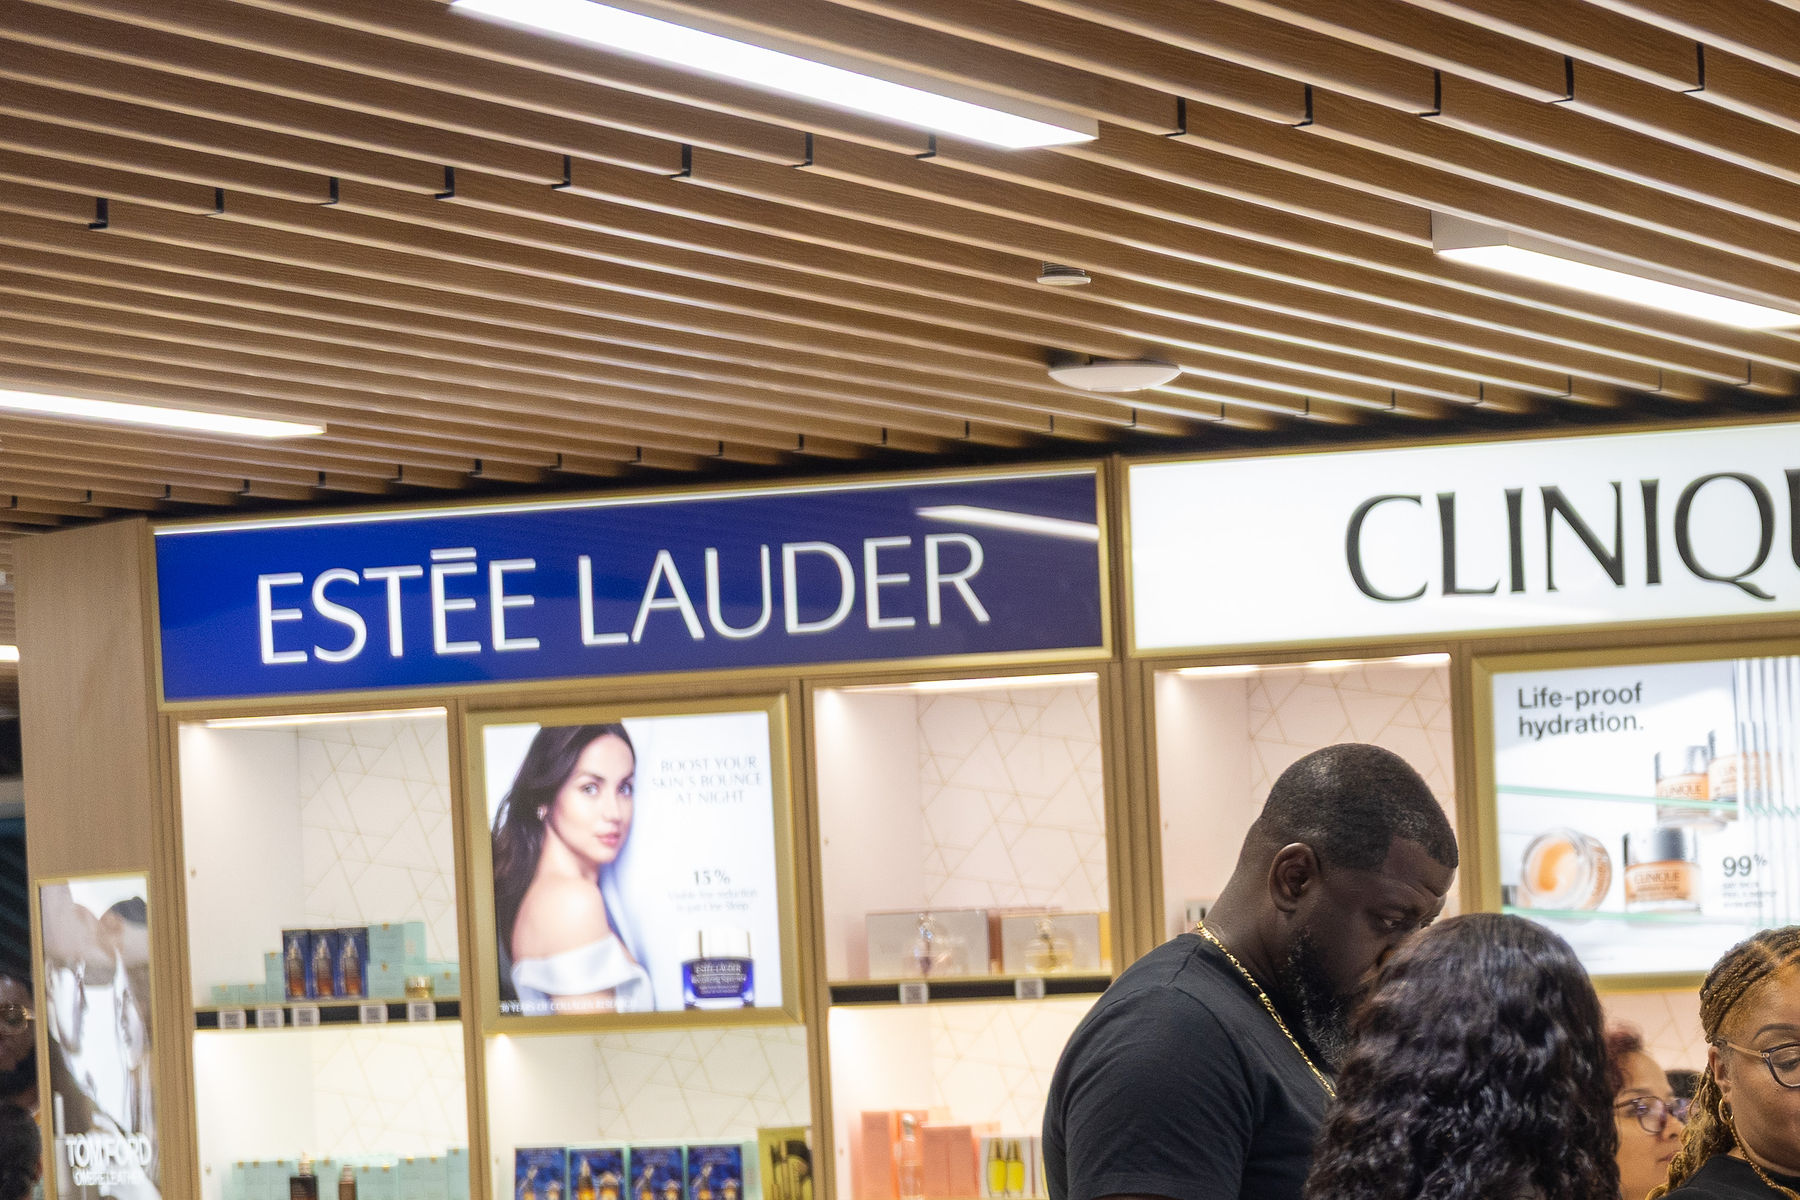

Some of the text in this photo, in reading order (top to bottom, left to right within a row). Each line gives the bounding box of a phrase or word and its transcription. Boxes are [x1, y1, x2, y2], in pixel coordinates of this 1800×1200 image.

[578, 533, 990, 646] LAUDER
[1518, 682, 1642, 711] Life-proof
[1518, 712, 1644, 741] hydration.
[660, 755, 758, 773] BOOST YOUR
[698, 790, 745, 804] NIGHT
